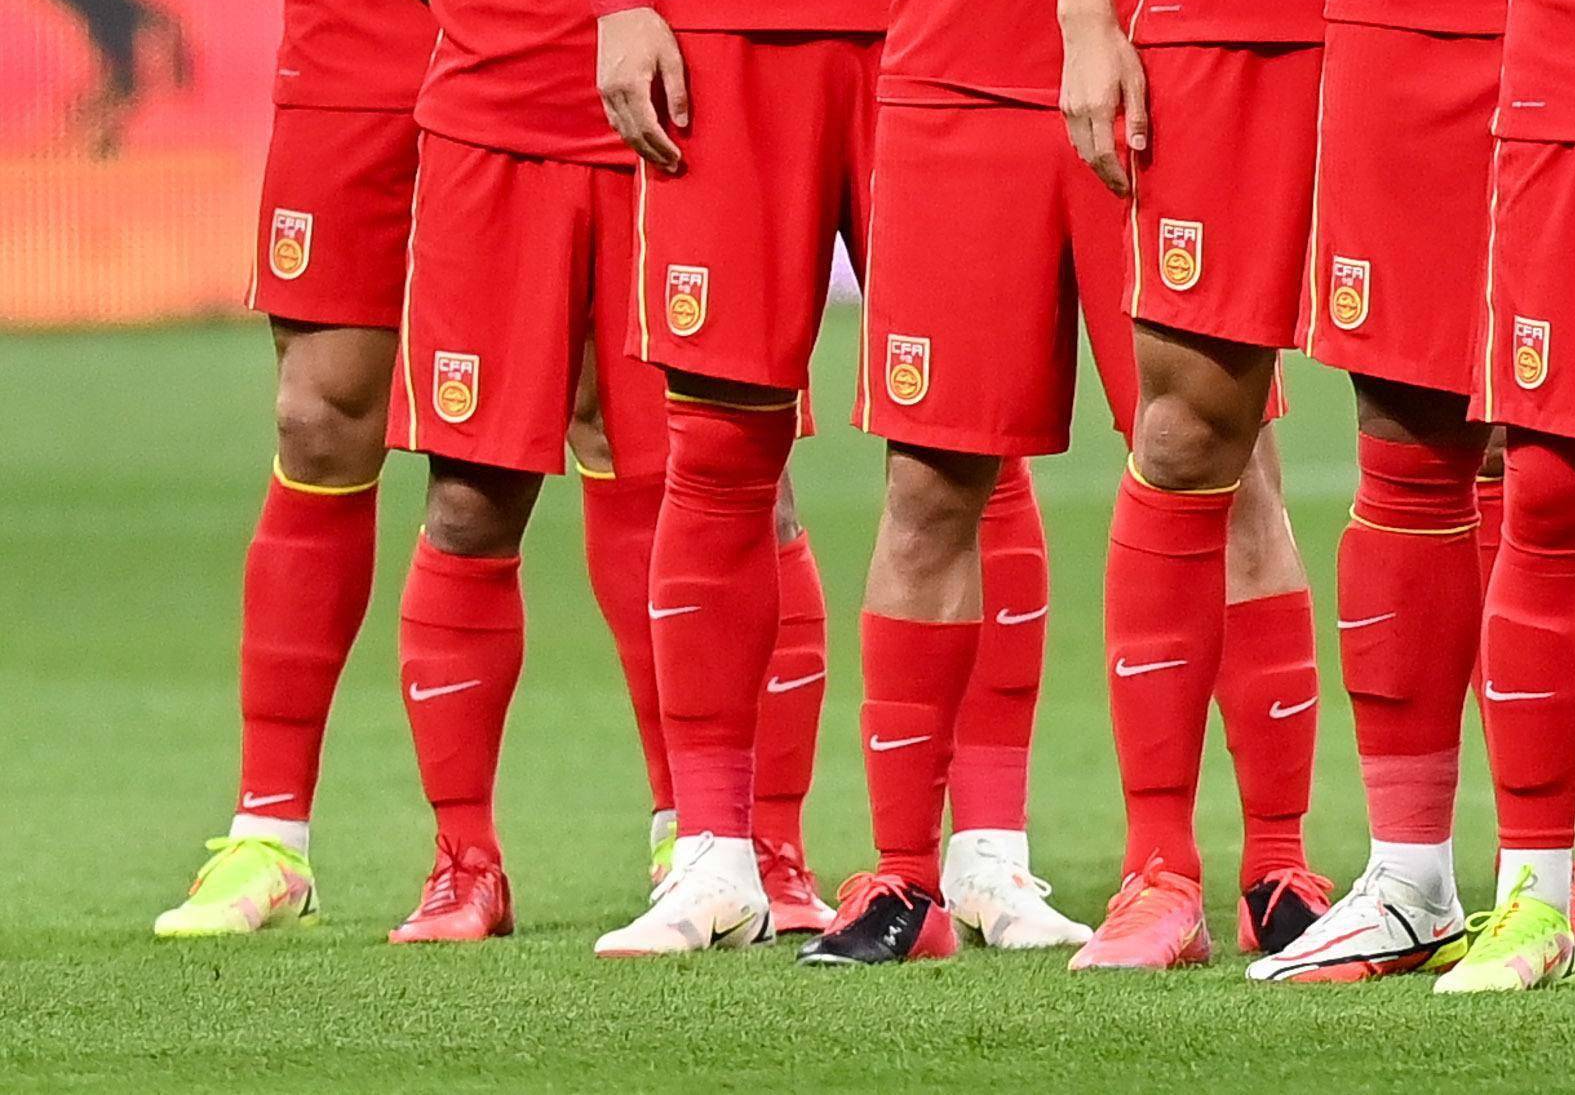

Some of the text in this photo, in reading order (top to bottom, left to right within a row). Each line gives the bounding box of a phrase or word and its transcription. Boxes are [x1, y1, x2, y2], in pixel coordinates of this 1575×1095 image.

[275, 216, 306, 232] CFA
[1163, 226, 1196, 242] CFA
[671, 272, 703, 287] CFA
[1335, 264, 1364, 279] CFA
[1515, 324, 1544, 340] CFA
[890, 341, 923, 357] CFA
[438, 357, 472, 374] CFA
